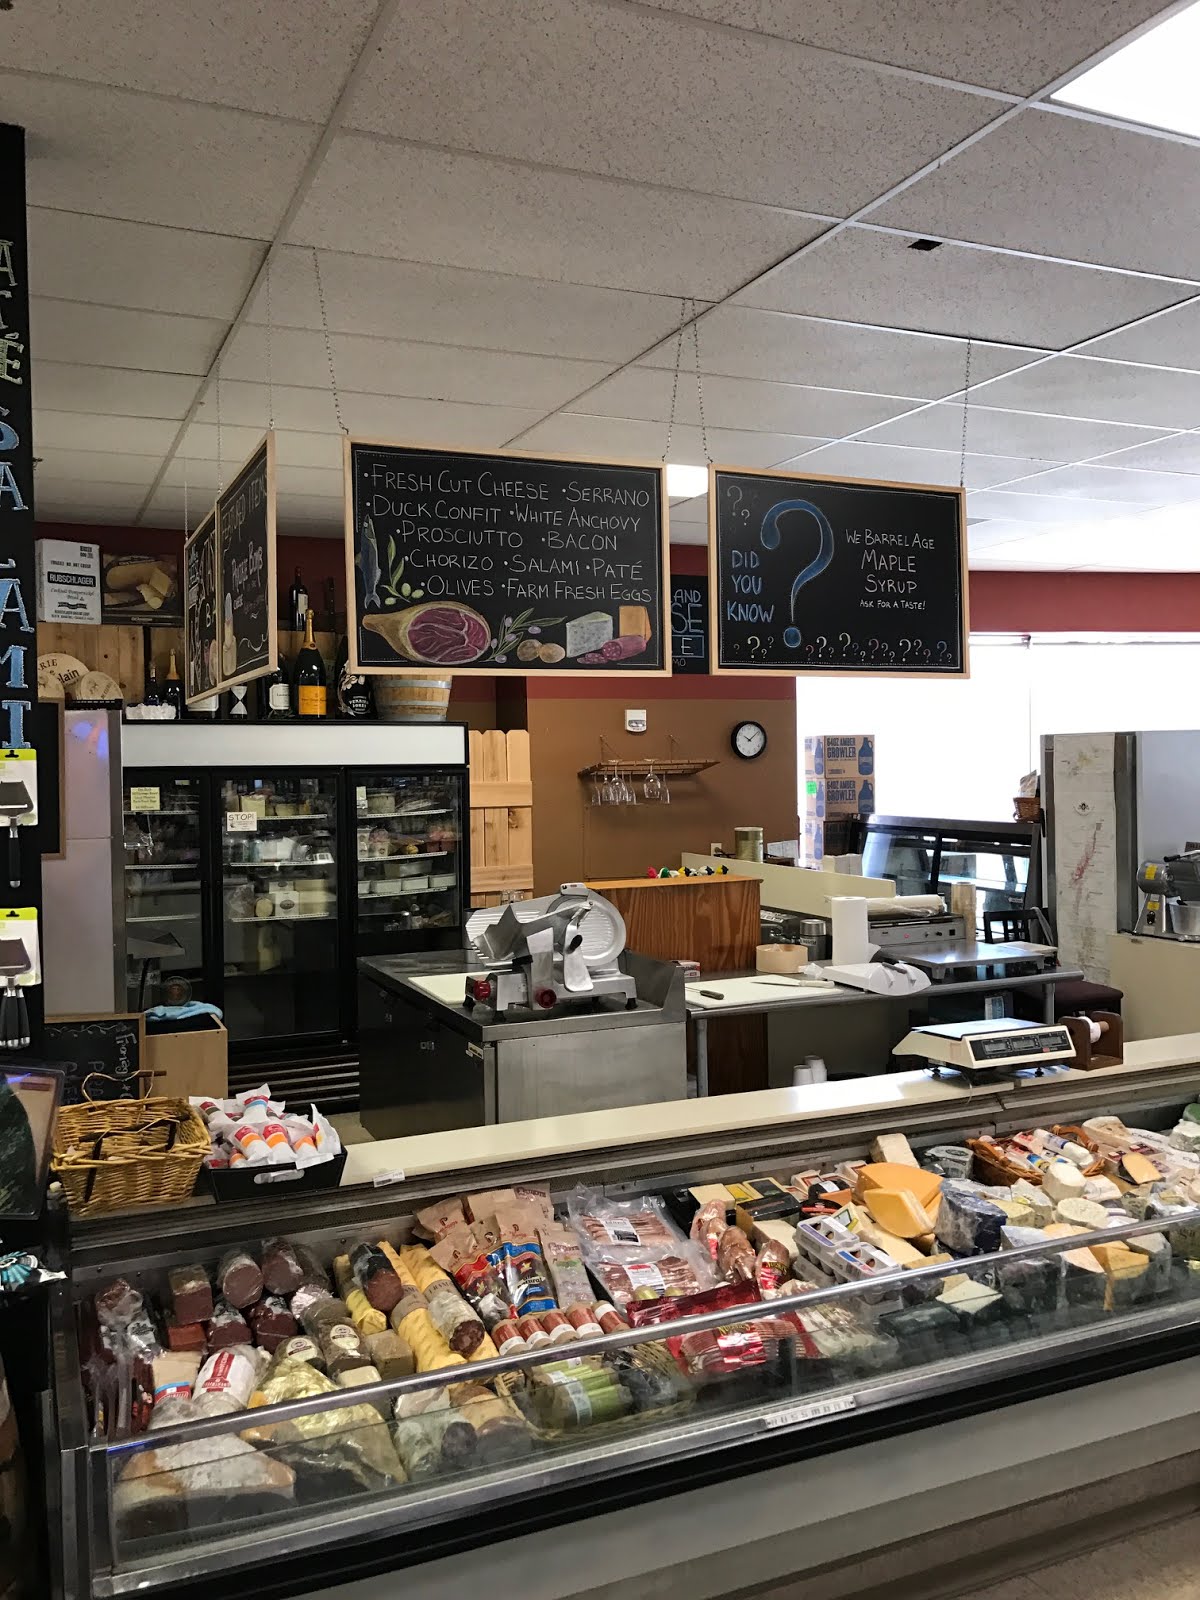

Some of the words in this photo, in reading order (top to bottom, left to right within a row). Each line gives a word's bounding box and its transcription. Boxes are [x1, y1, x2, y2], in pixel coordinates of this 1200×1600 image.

[370, 463, 432, 492] FRESH
[437, 470, 472, 493] CUT
[477, 471, 549, 501] CHEESE
[565, 481, 650, 507] SERRANO
[373, 495, 434, 519] DUCK
[435, 500, 501, 523] CONFIT
[514, 503, 563, 526] WHITE
[568, 507, 641, 532] ANCHOVY
[402, 520, 524, 549] PROSCIUTTO
[548, 531, 618, 551] BACON
[864, 529, 911, 548] BARREL
[911, 533, 935, 550] AGE
[410, 549, 494, 570] CHORIZO
[509, 555, 580, 576] SALAMI
[731, 550, 760, 569] DID
[861, 550, 917, 573] MAPLE
[426, 575, 495, 597] OLIVES
[506, 578, 549, 600] FARM
[553, 580, 605, 601] FRESH
[610, 583, 652, 603] EGGS
[731, 575, 762, 595] YOU
[864, 574, 918, 594] SYRUP
[673, 589, 701, 603] AND
[859, 600, 874, 609] ASK
[877, 600, 891, 609] FOR
[893, 600, 900, 609] A
[900, 600, 926, 611] TASTE!
[727, 601, 775, 623] KNOW
[826, 746, 857, 758] GROWLER
[826, 789, 857, 801] GROWLER
